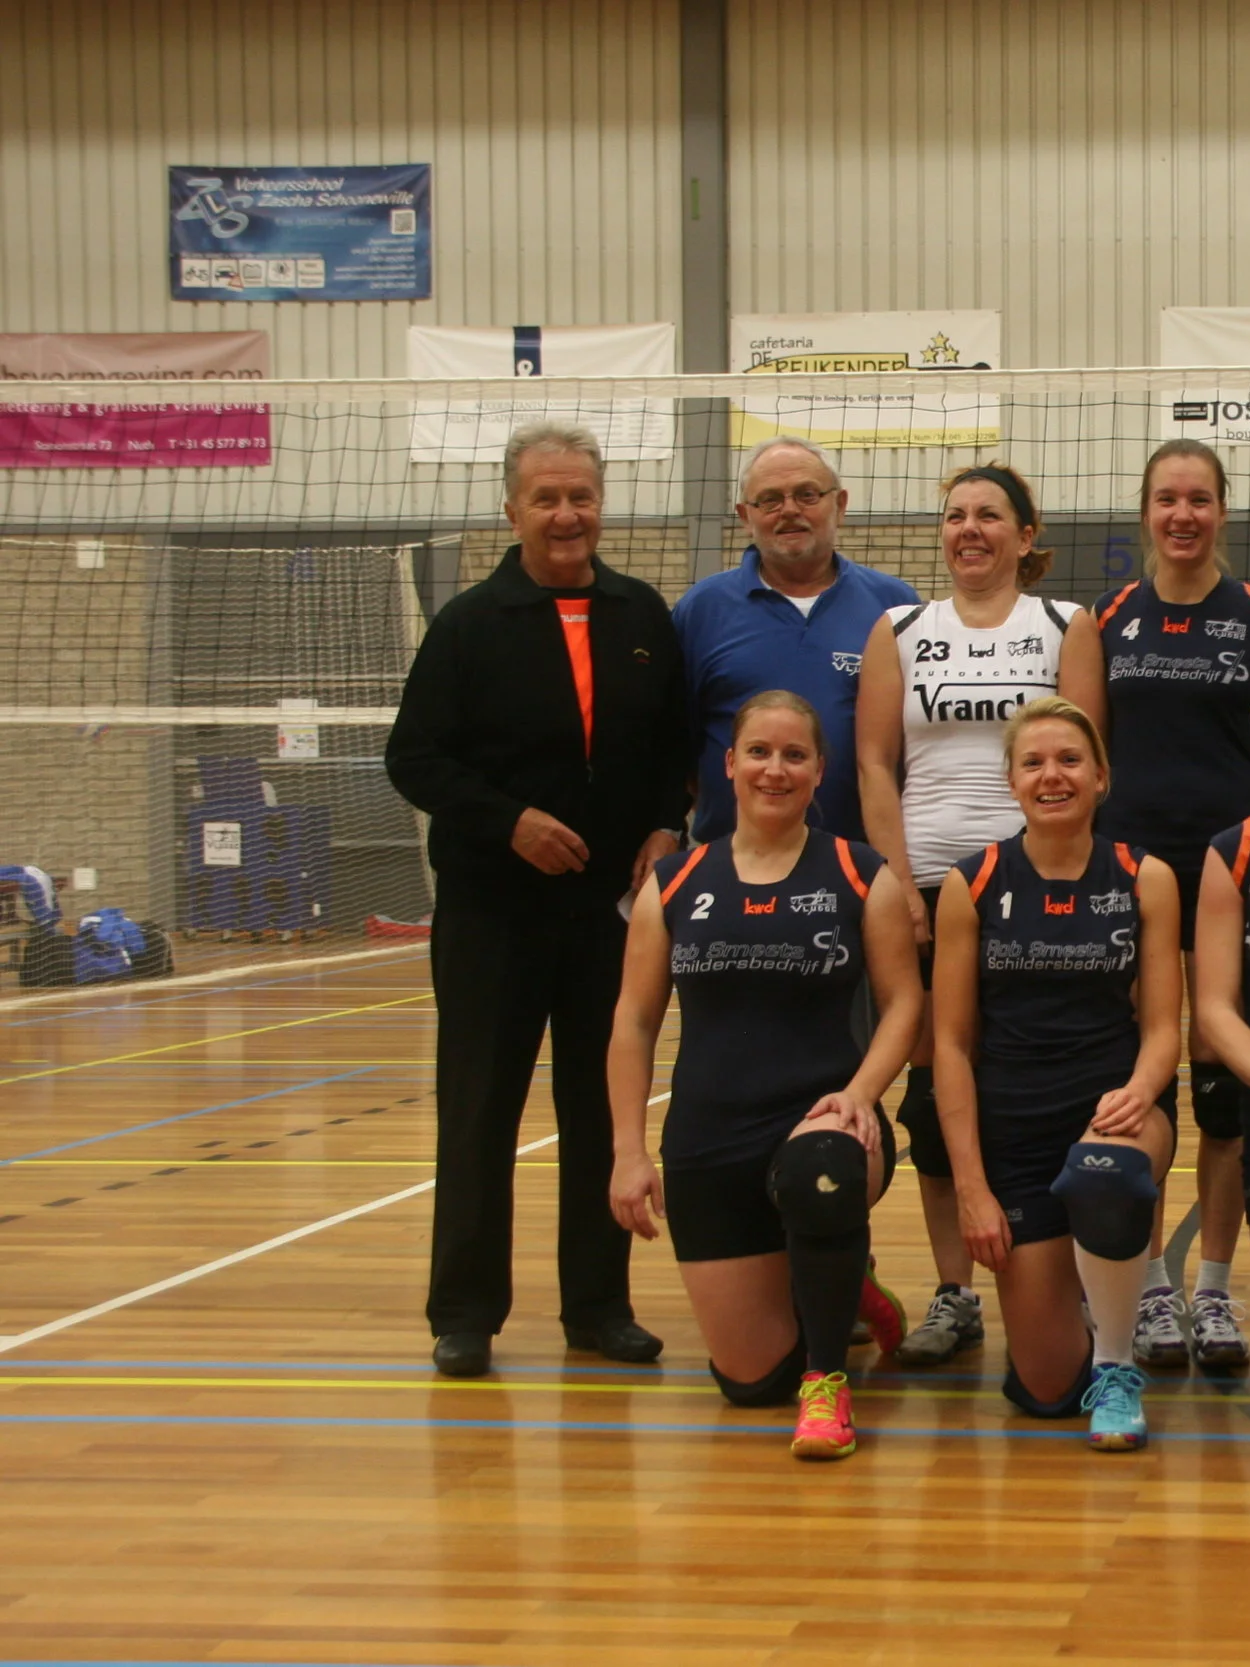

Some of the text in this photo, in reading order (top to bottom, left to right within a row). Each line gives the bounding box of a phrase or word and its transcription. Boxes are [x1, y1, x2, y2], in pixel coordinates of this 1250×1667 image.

[235, 177, 344, 192] Verkeersschool
[749, 336, 814, 350] cafetaria
[1101, 537, 1134, 578] 5
[1121, 617, 1141, 641] 4
[915, 639, 950, 663] 23
[1110, 666, 1222, 685] Schildersbedrijf
[690, 892, 716, 920] 2
[1000, 891, 1014, 919] 1
[672, 957, 821, 976] Schildersbedrijf
[988, 956, 1117, 973] Schildersbedrijf
